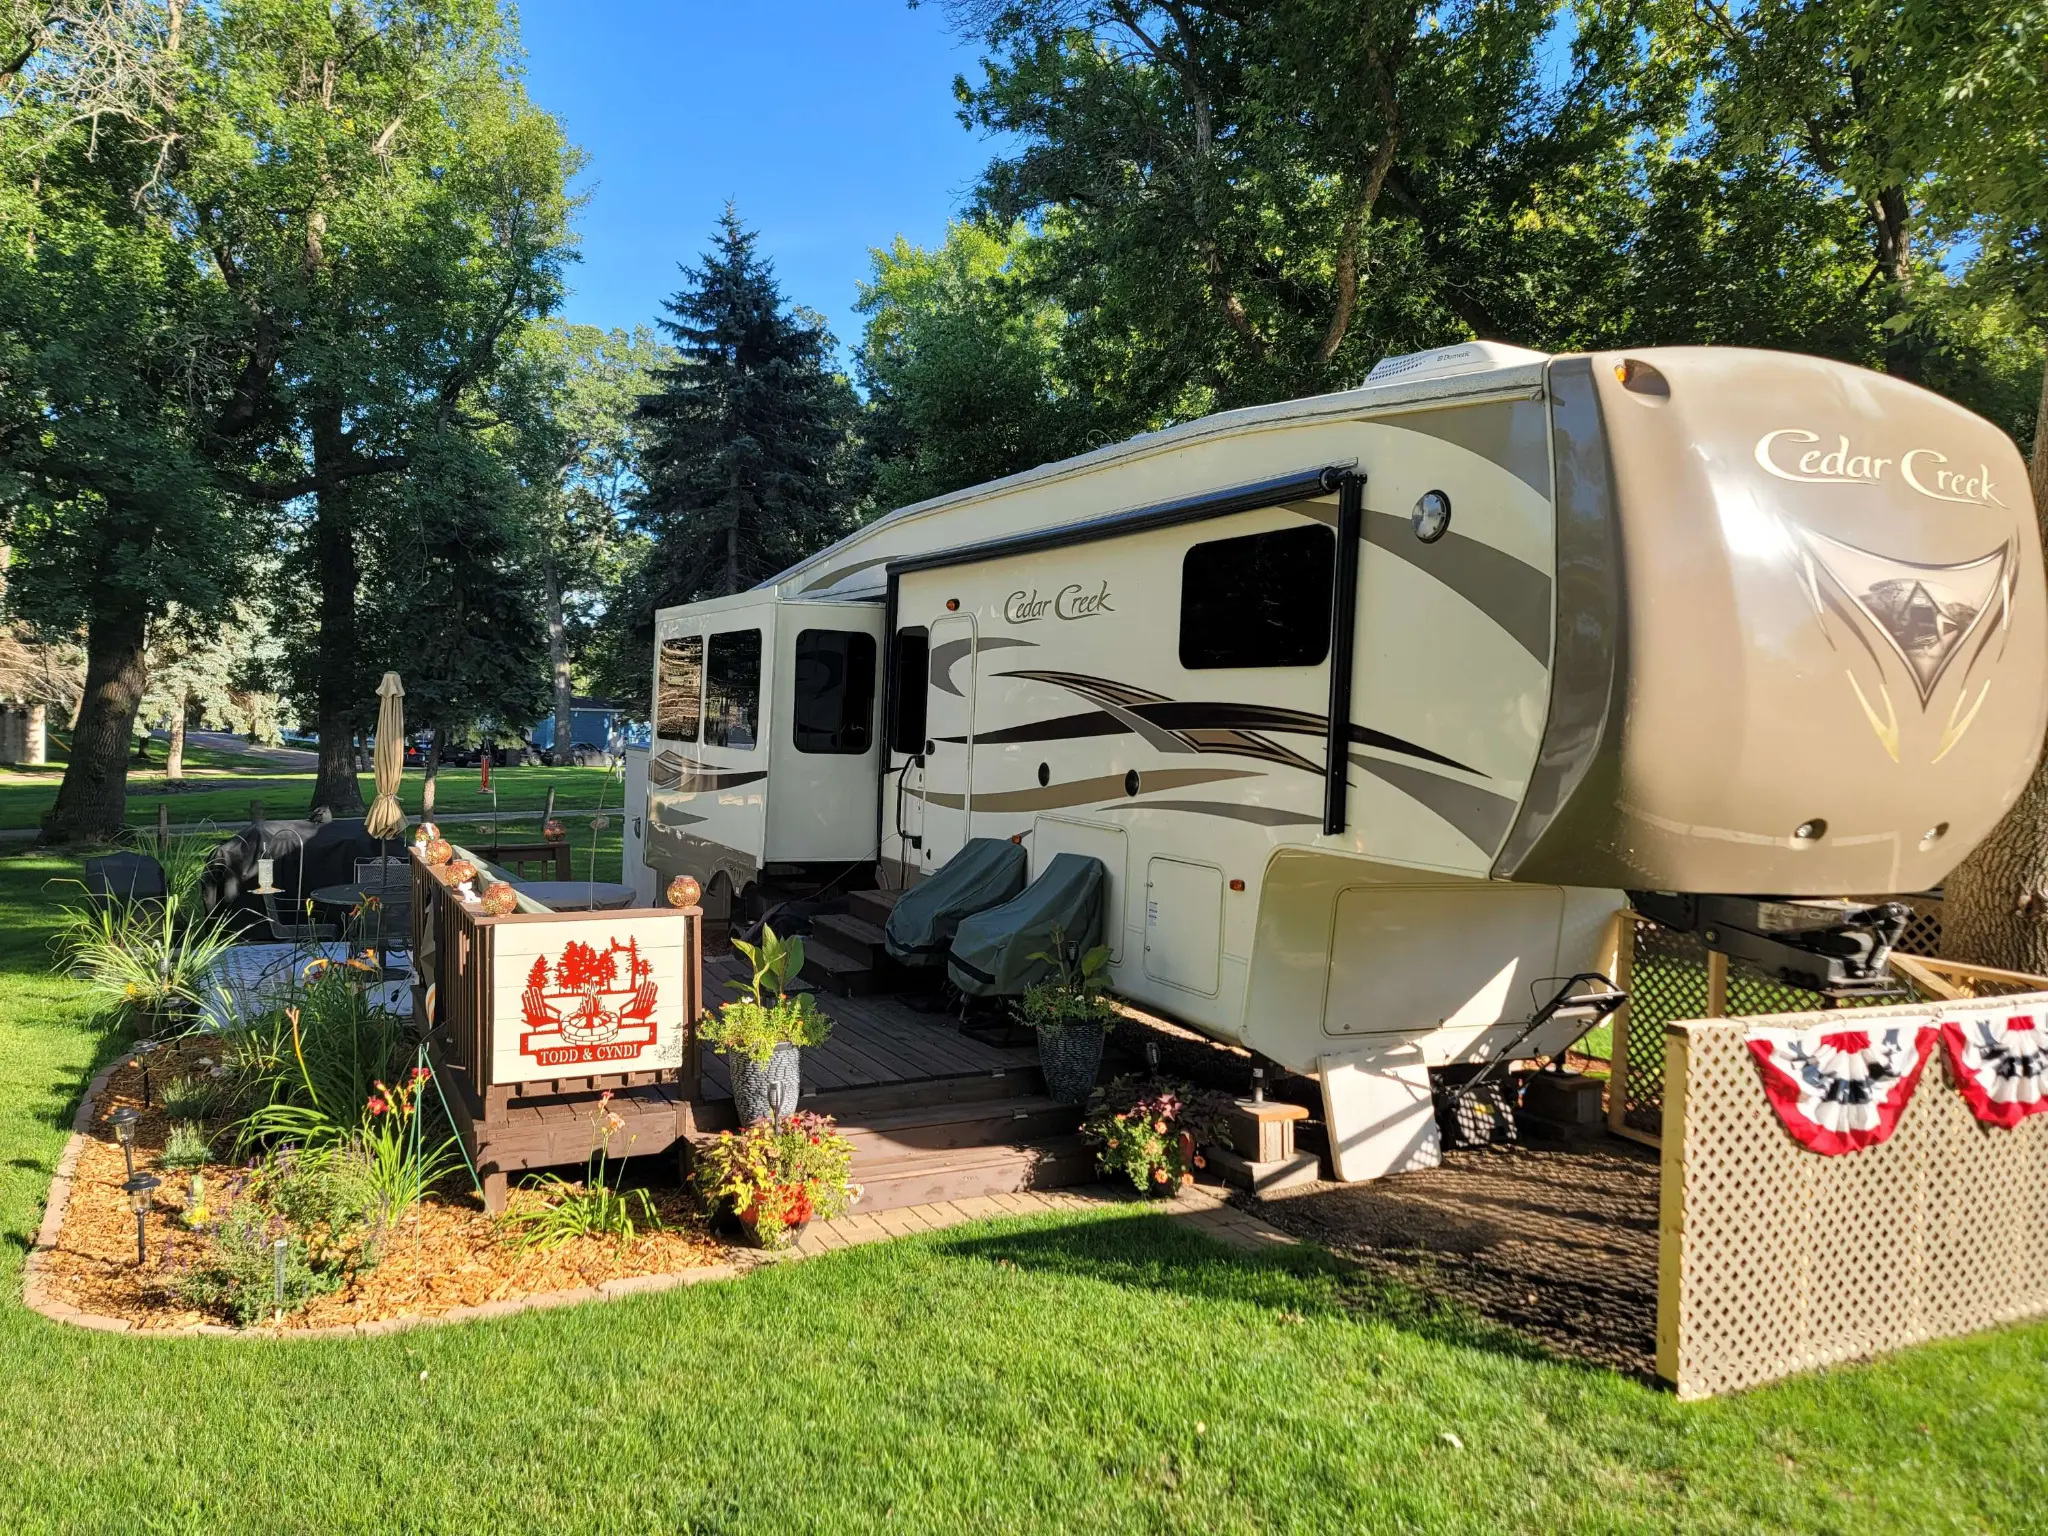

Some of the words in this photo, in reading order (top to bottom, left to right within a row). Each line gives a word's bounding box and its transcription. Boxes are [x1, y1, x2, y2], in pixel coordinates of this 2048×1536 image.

[1755, 428, 1892, 486] Cedar
[1900, 449, 2010, 510] Creek
[1004, 589, 1052, 624] Cedar
[1055, 580, 1115, 620] Creek
[541, 1049, 579, 1064] TODD
[582, 1048, 593, 1060] &
[597, 1044, 638, 1059] CYNDI
